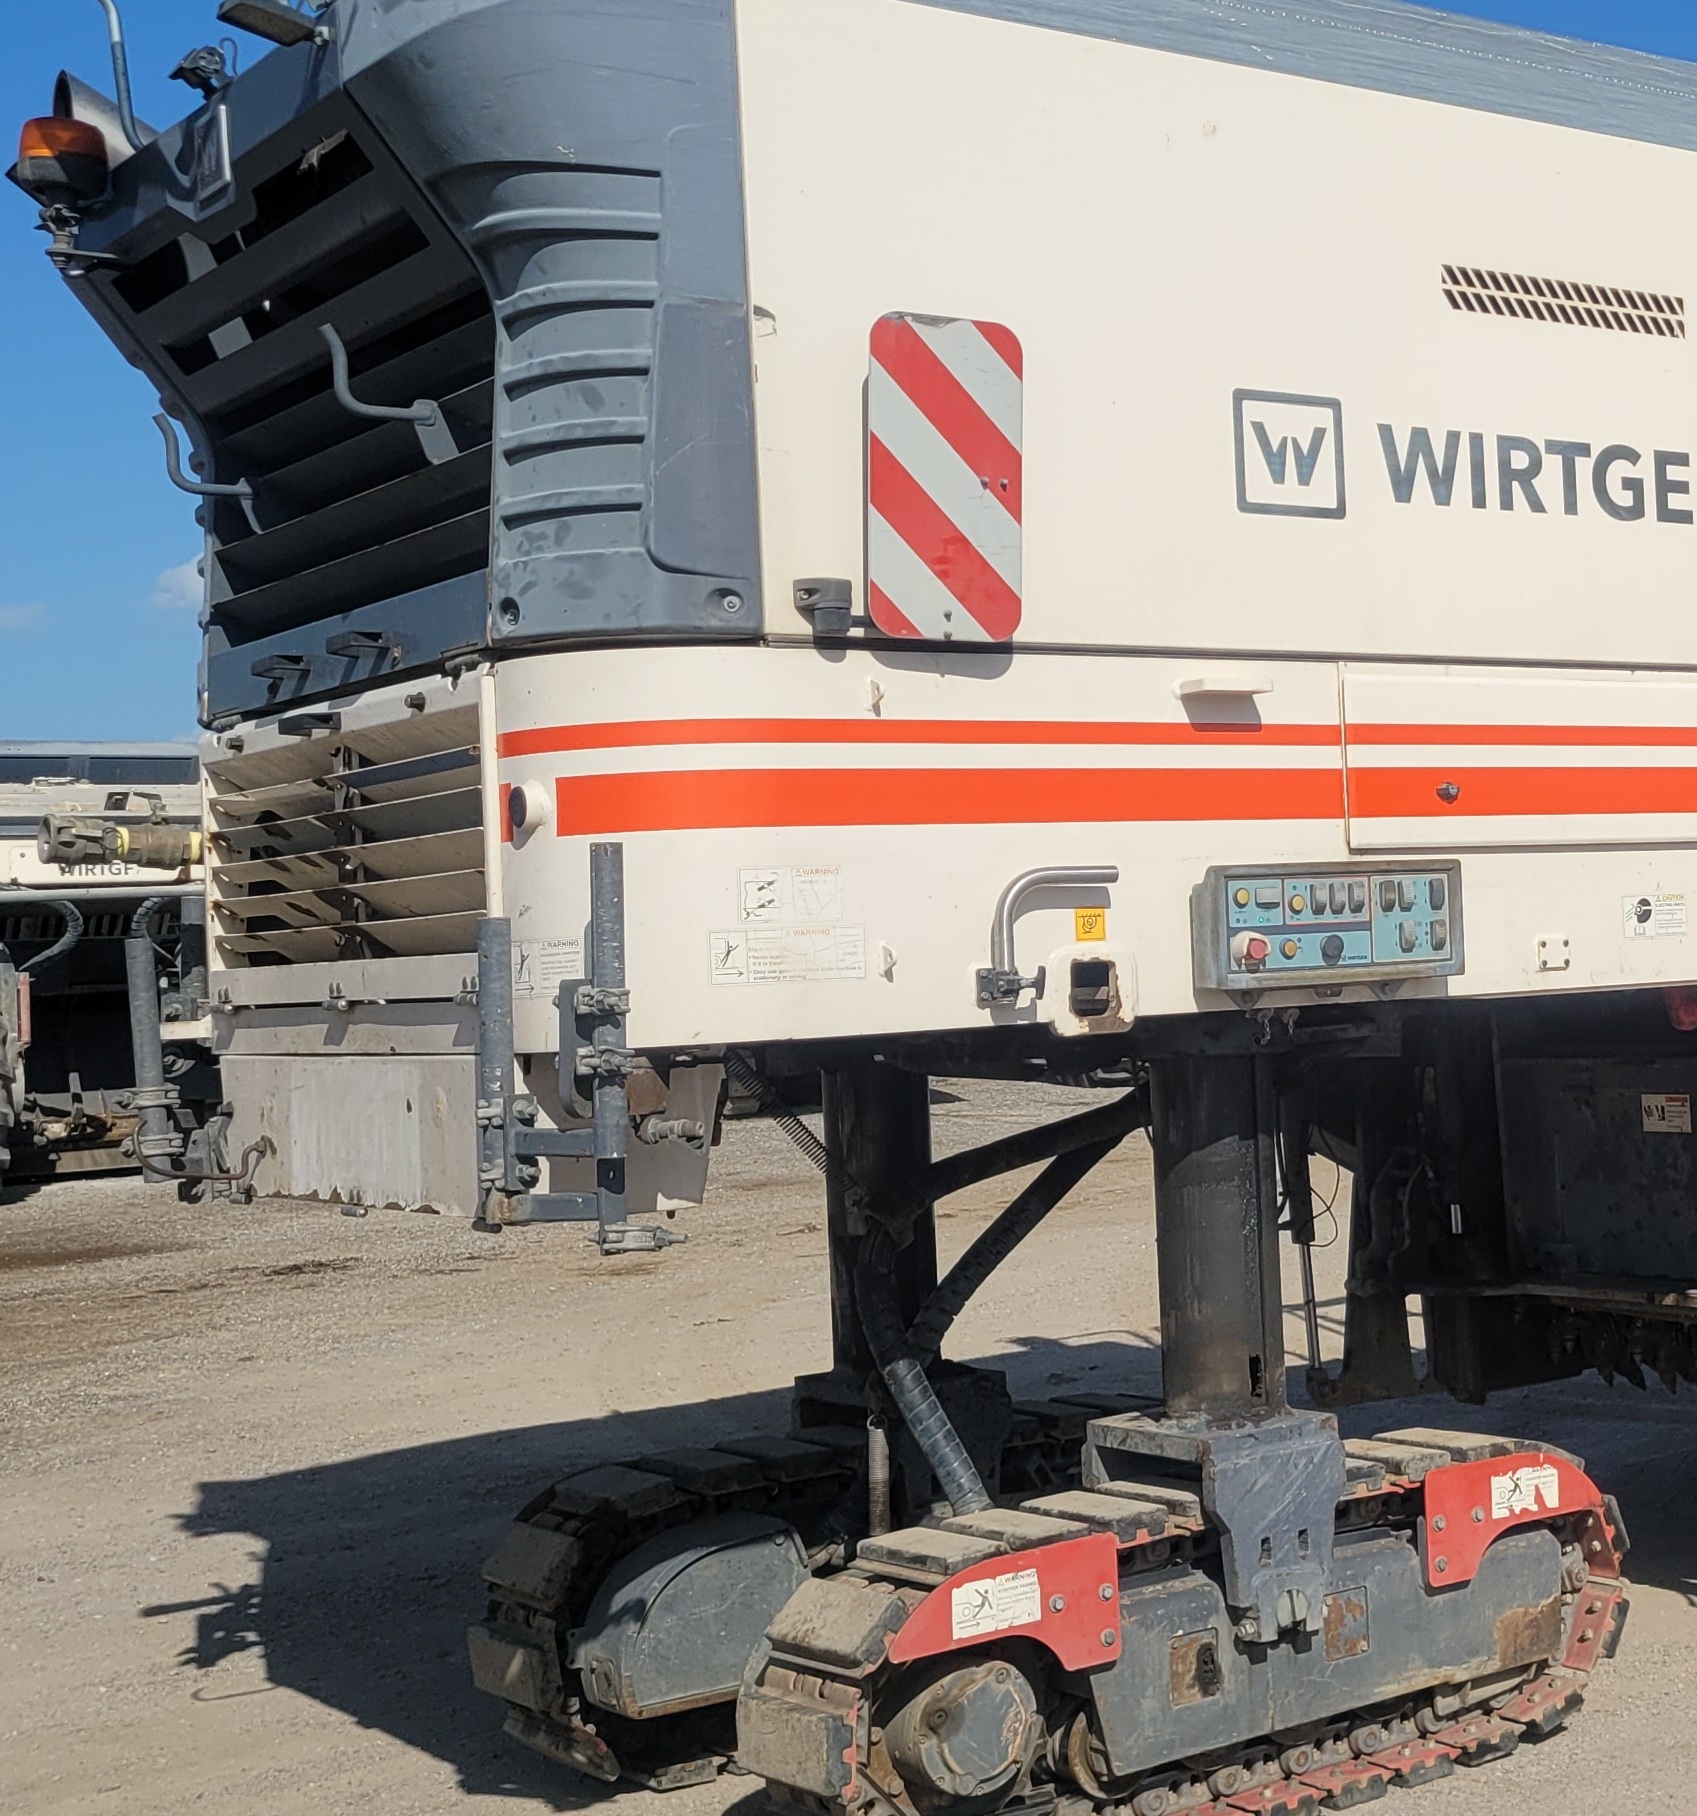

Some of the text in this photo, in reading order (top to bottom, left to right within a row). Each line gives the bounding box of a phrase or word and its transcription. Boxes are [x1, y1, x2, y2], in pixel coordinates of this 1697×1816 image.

[803, 868, 839, 876] WARNING
[793, 928, 831, 937] WARNING
[547, 940, 579, 948] WARNING
[1005, 1570, 1036, 1583] WARNING
